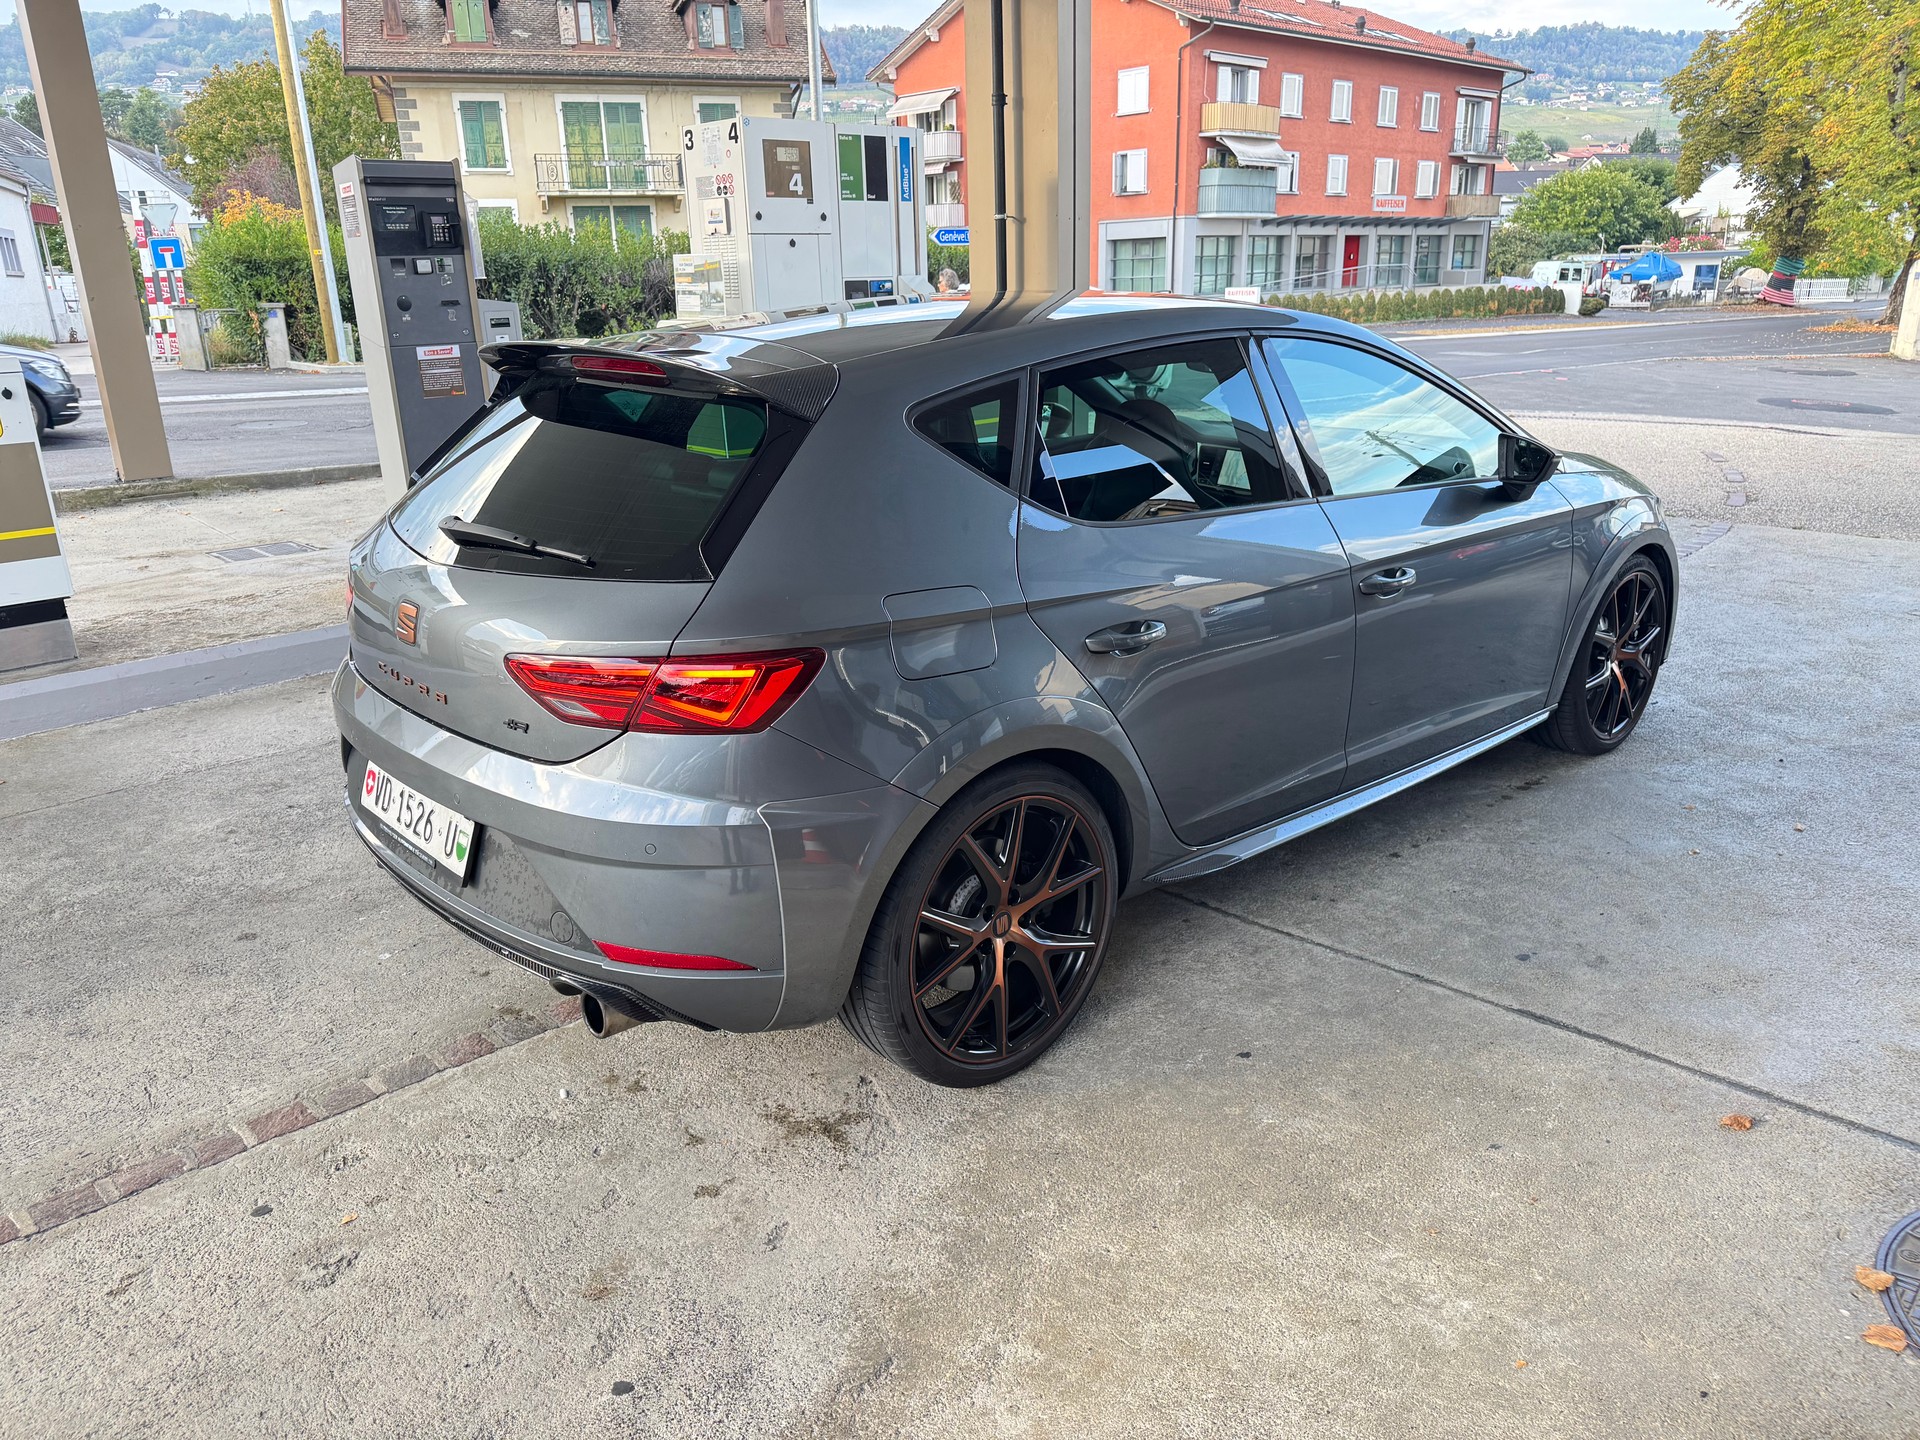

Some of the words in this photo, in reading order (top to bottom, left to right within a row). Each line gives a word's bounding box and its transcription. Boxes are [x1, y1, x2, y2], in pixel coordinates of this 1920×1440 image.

[685, 129, 694, 151] 3
[728, 121, 739, 144] 4
[789, 172, 804, 196] 4
[377, 660, 448, 705] CUPRA
